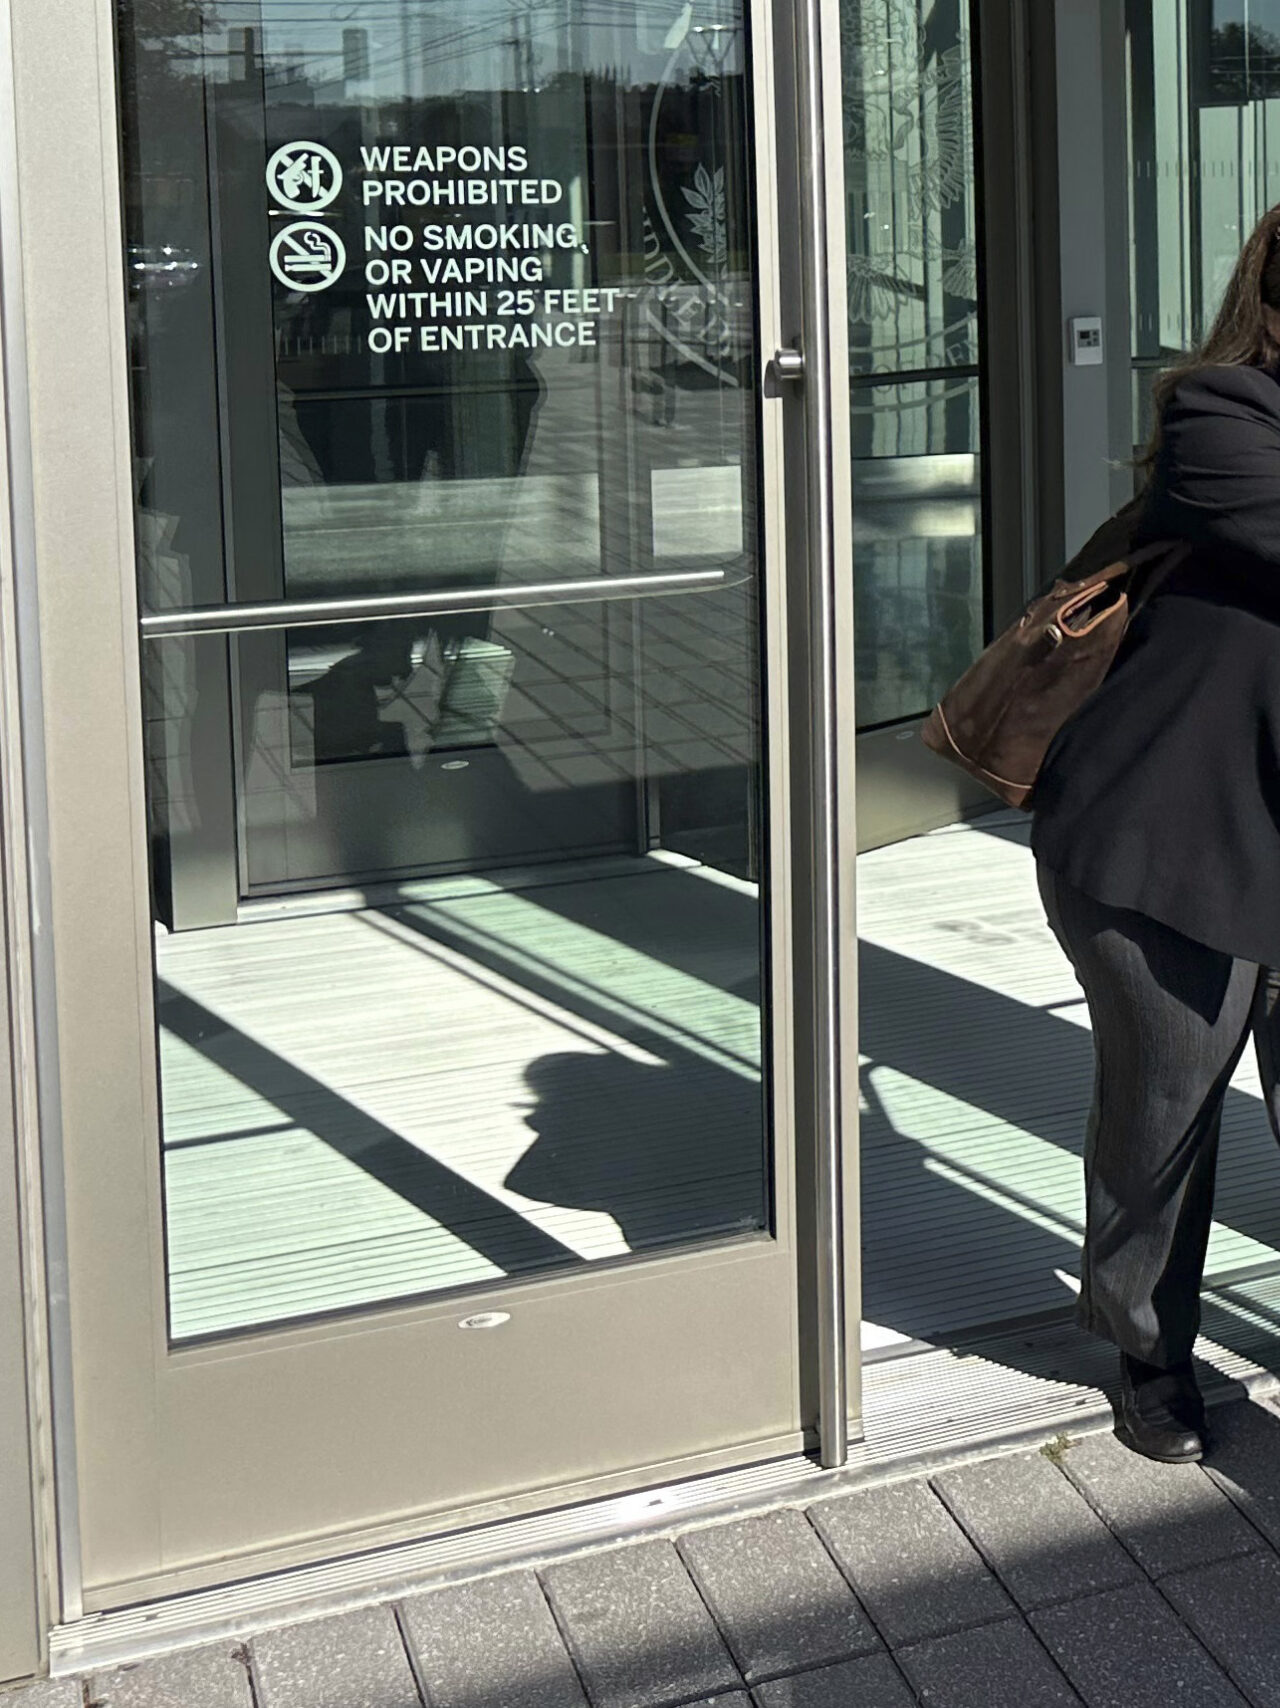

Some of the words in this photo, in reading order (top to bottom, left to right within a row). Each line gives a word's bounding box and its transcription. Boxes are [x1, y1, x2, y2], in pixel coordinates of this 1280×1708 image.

[360, 146, 528, 173] WEAPONS
[362, 179, 563, 206] PROHIBITED
[365, 225, 414, 251] NO
[365, 258, 412, 286] OR
[420, 257, 543, 284] VAPING
[367, 291, 487, 319] WITHIN
[497, 289, 536, 316] 25
[544, 288, 620, 314] FEET
[367, 326, 411, 354] OF
[421, 321, 597, 351] ENTRANCE
